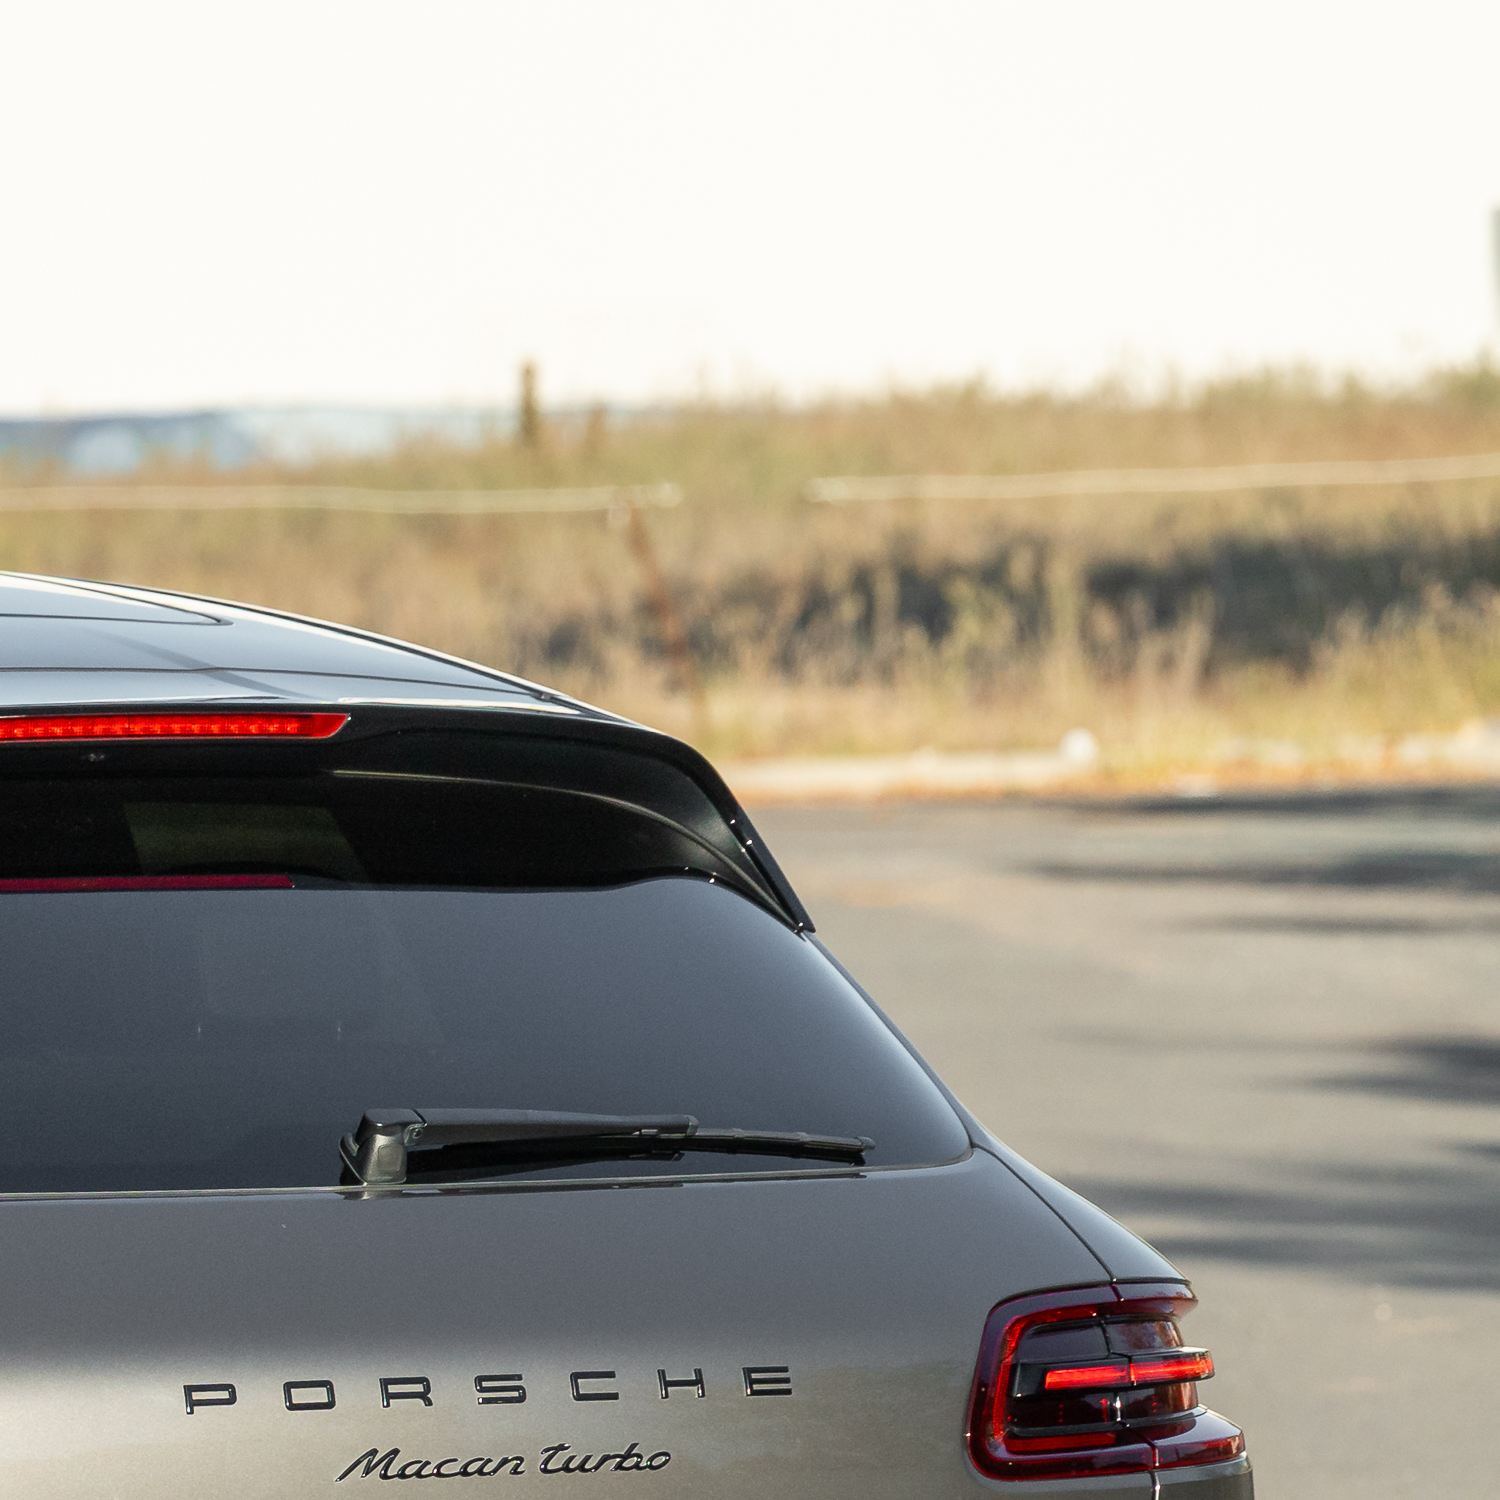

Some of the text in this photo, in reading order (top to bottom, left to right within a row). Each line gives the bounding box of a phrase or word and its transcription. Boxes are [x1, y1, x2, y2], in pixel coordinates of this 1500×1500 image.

[183, 1364, 792, 1415] PORSCHE
[335, 1442, 672, 1482] Macan turbo
